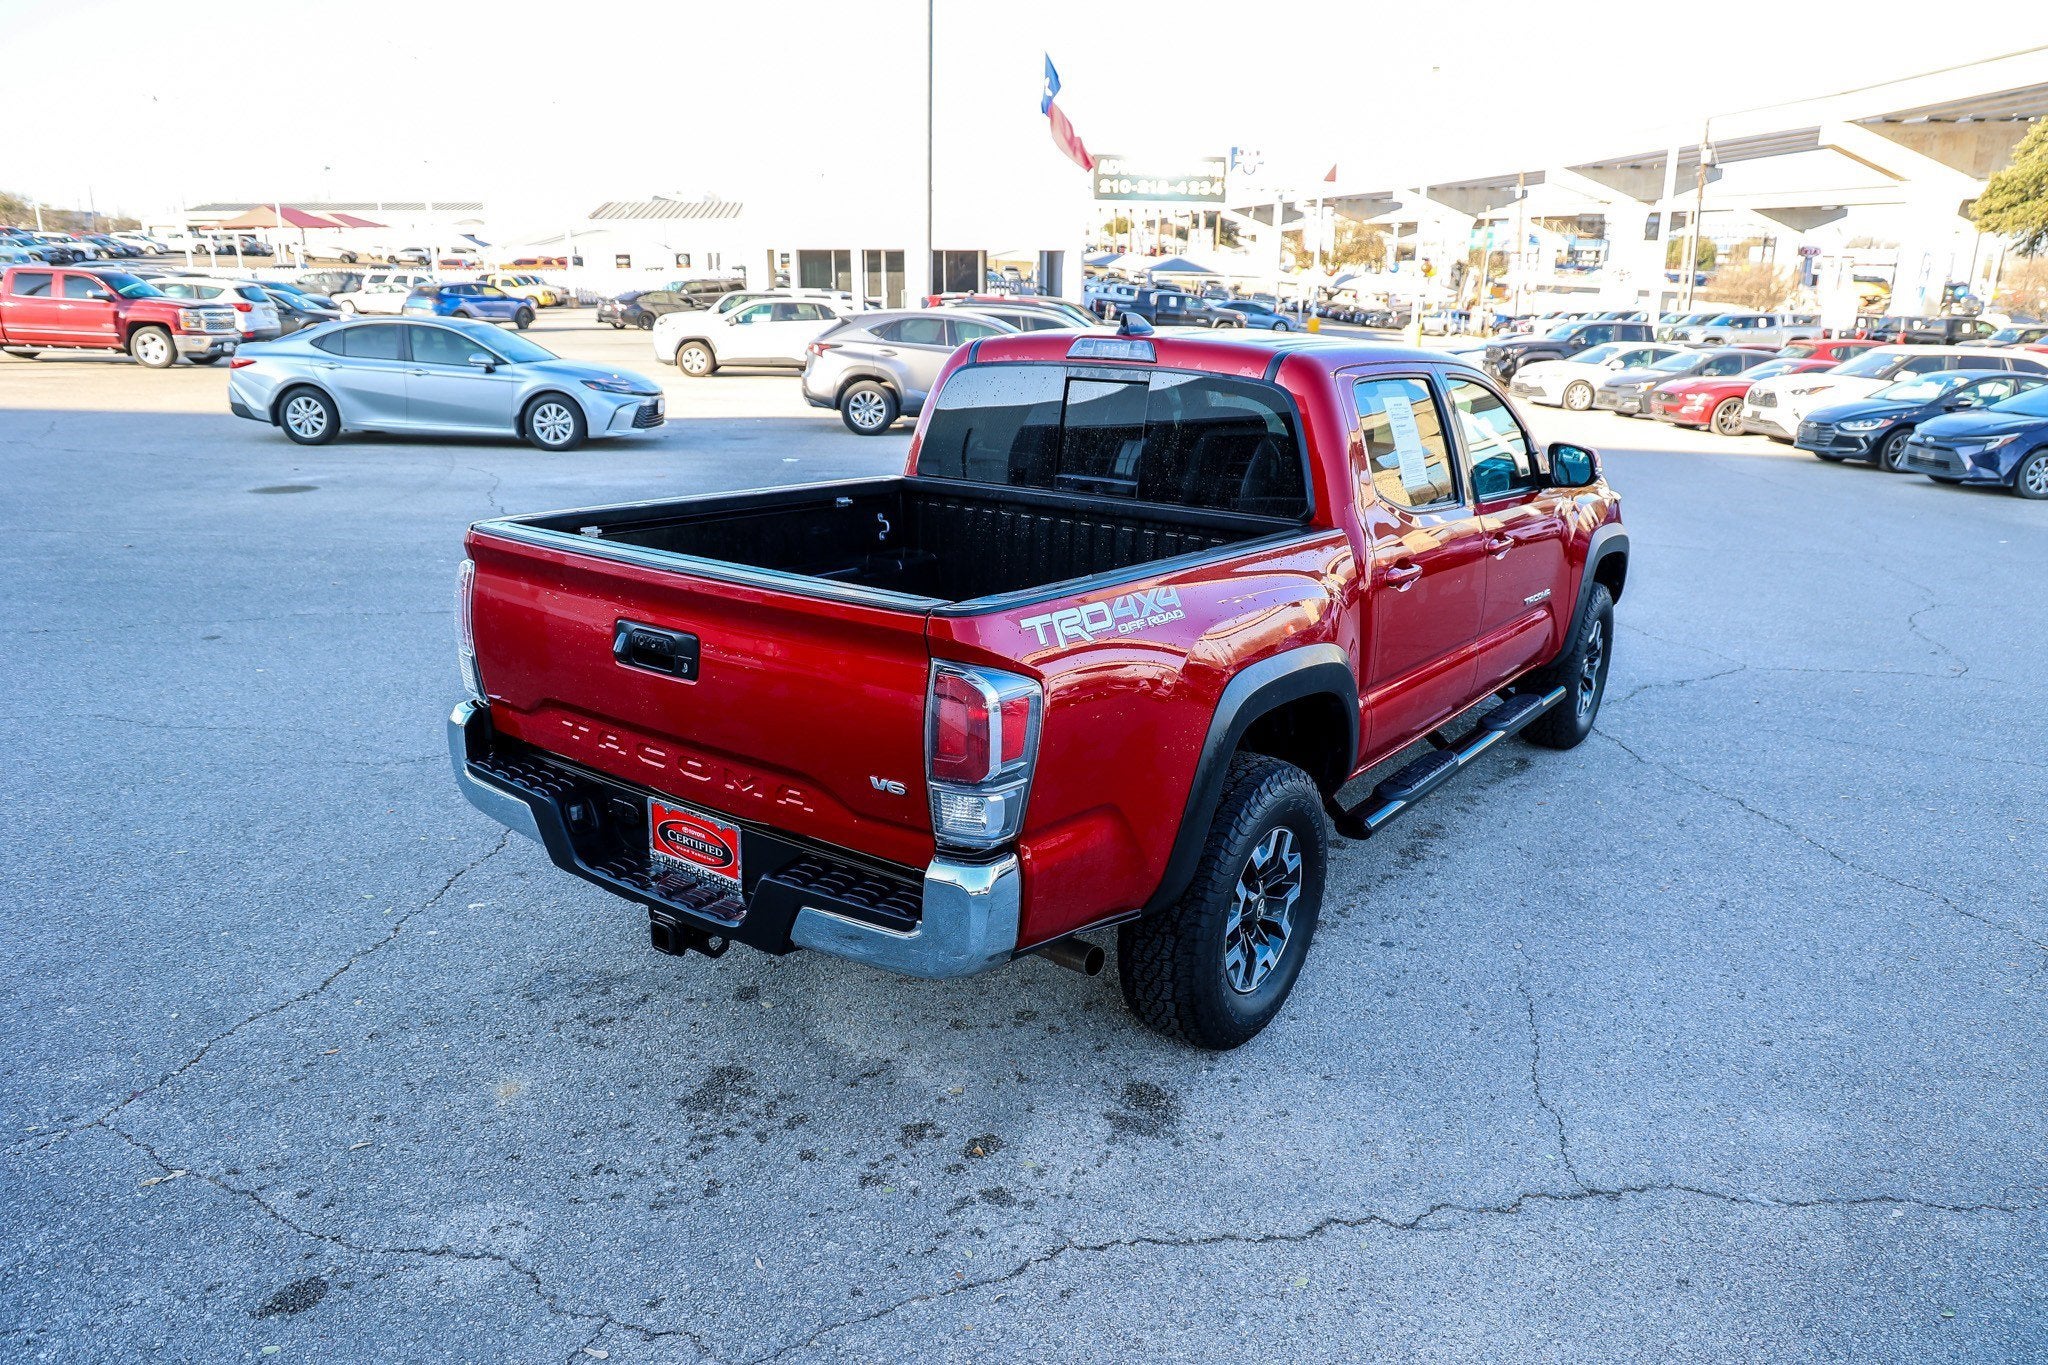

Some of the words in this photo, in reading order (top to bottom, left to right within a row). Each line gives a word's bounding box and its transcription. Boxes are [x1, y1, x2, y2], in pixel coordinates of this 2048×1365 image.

[1020, 601, 1115, 650] TRD
[1117, 619, 1147, 635] OFF
[1147, 609, 1186, 628] ROAD
[561, 719, 814, 813] TACOMA
[869, 775, 907, 795] V6
[687, 828, 706, 839] TOYOTA
